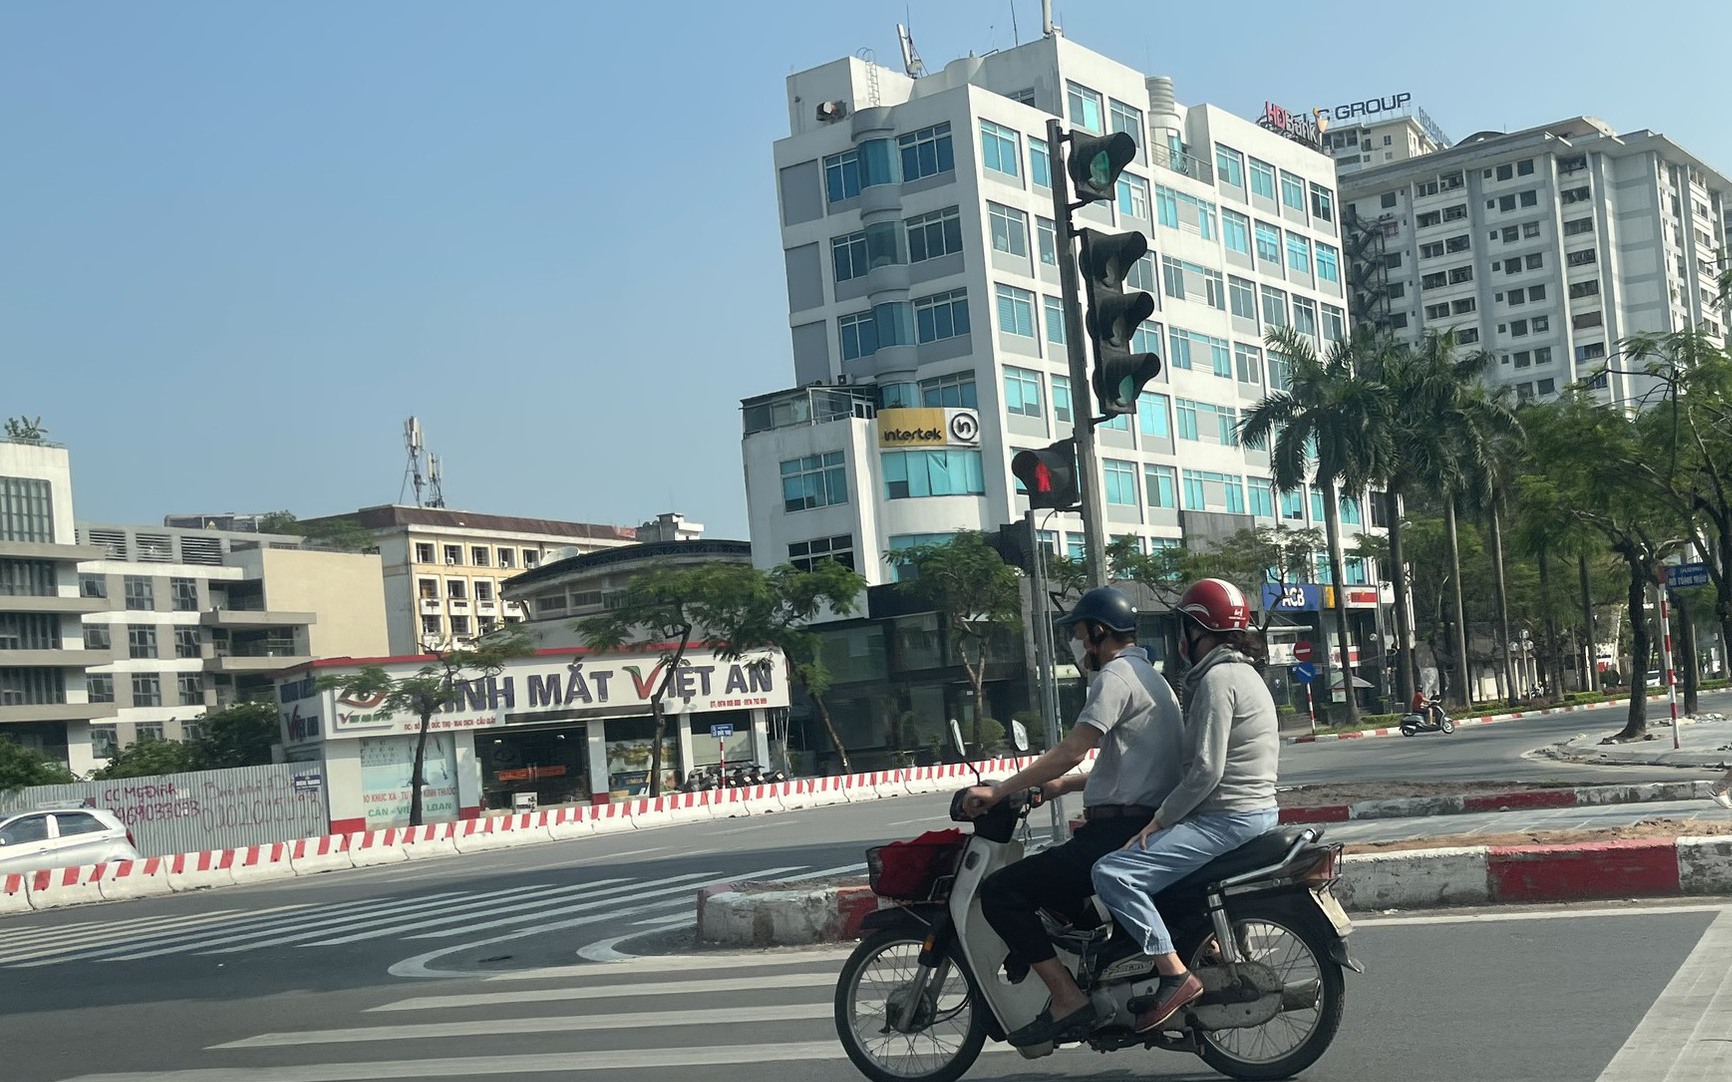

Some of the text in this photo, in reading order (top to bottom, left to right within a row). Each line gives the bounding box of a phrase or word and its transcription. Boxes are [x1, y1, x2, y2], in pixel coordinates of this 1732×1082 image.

[1335, 92, 1411, 120] GROUP
[1265, 101, 1318, 143] HDBank
[884, 427, 942, 442] intertek
[1282, 588, 1305, 607] ACB
[528, 656, 613, 707] MẮT
[725, 660, 773, 694] AN
